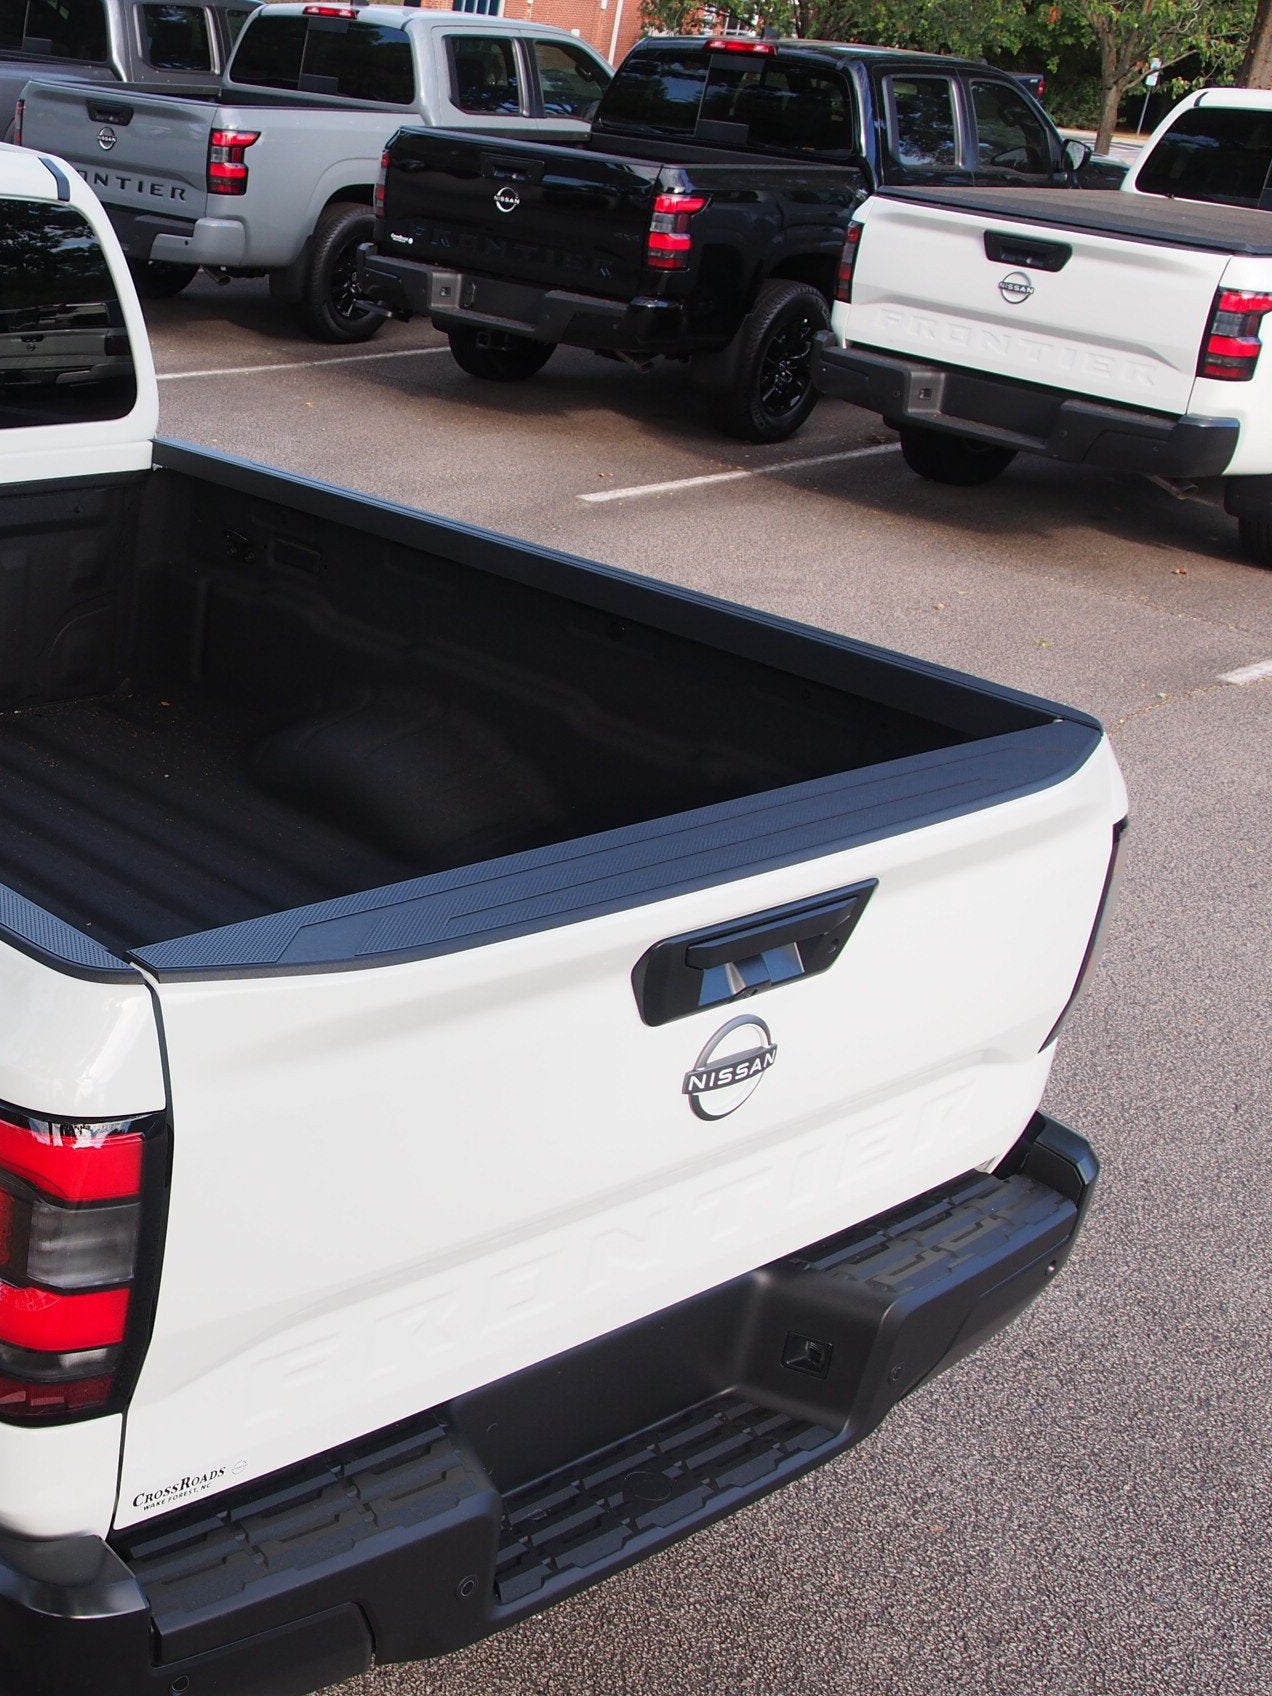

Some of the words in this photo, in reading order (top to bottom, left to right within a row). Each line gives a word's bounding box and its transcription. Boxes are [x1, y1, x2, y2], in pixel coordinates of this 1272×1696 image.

[76, 169, 187, 201] NTIER
[493, 195, 520, 205] NISSAN
[999, 281, 1034, 294] NISSAN
[876, 308, 1158, 387] FRONTIER
[687, 1048, 777, 1091] NISSAN
[244, 1081, 977, 1429] FRONTIER
[143, 1499, 166, 1511] WAKE
[201, 1482, 212, 1491] NC
